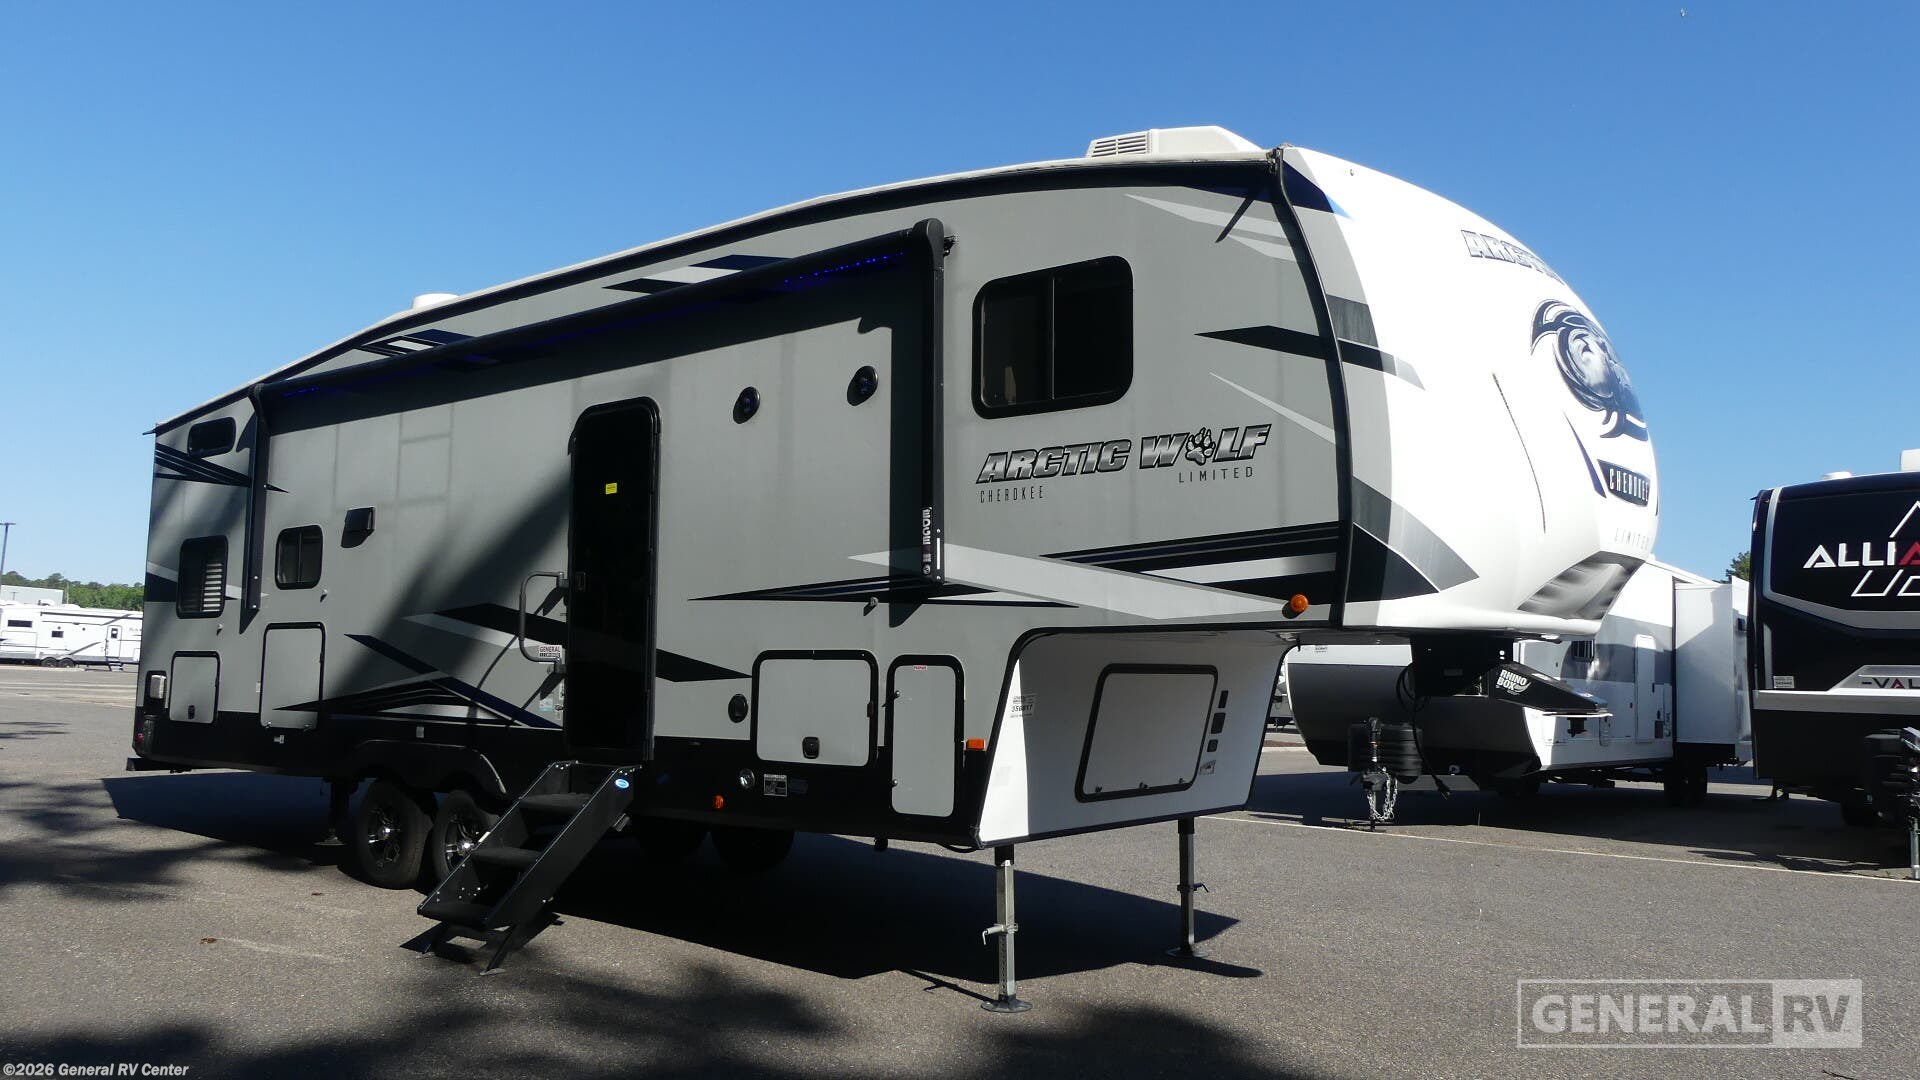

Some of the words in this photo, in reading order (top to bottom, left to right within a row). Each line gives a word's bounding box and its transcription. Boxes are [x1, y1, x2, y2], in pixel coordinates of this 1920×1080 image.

[976, 438, 1132, 484] ARCTIC
[1178, 466, 1254, 483] LIMITED
[980, 485, 1044, 503] CHEROKEE
[1496, 676, 1516, 691] BOX
[1500, 669, 1528, 686] RHINO
